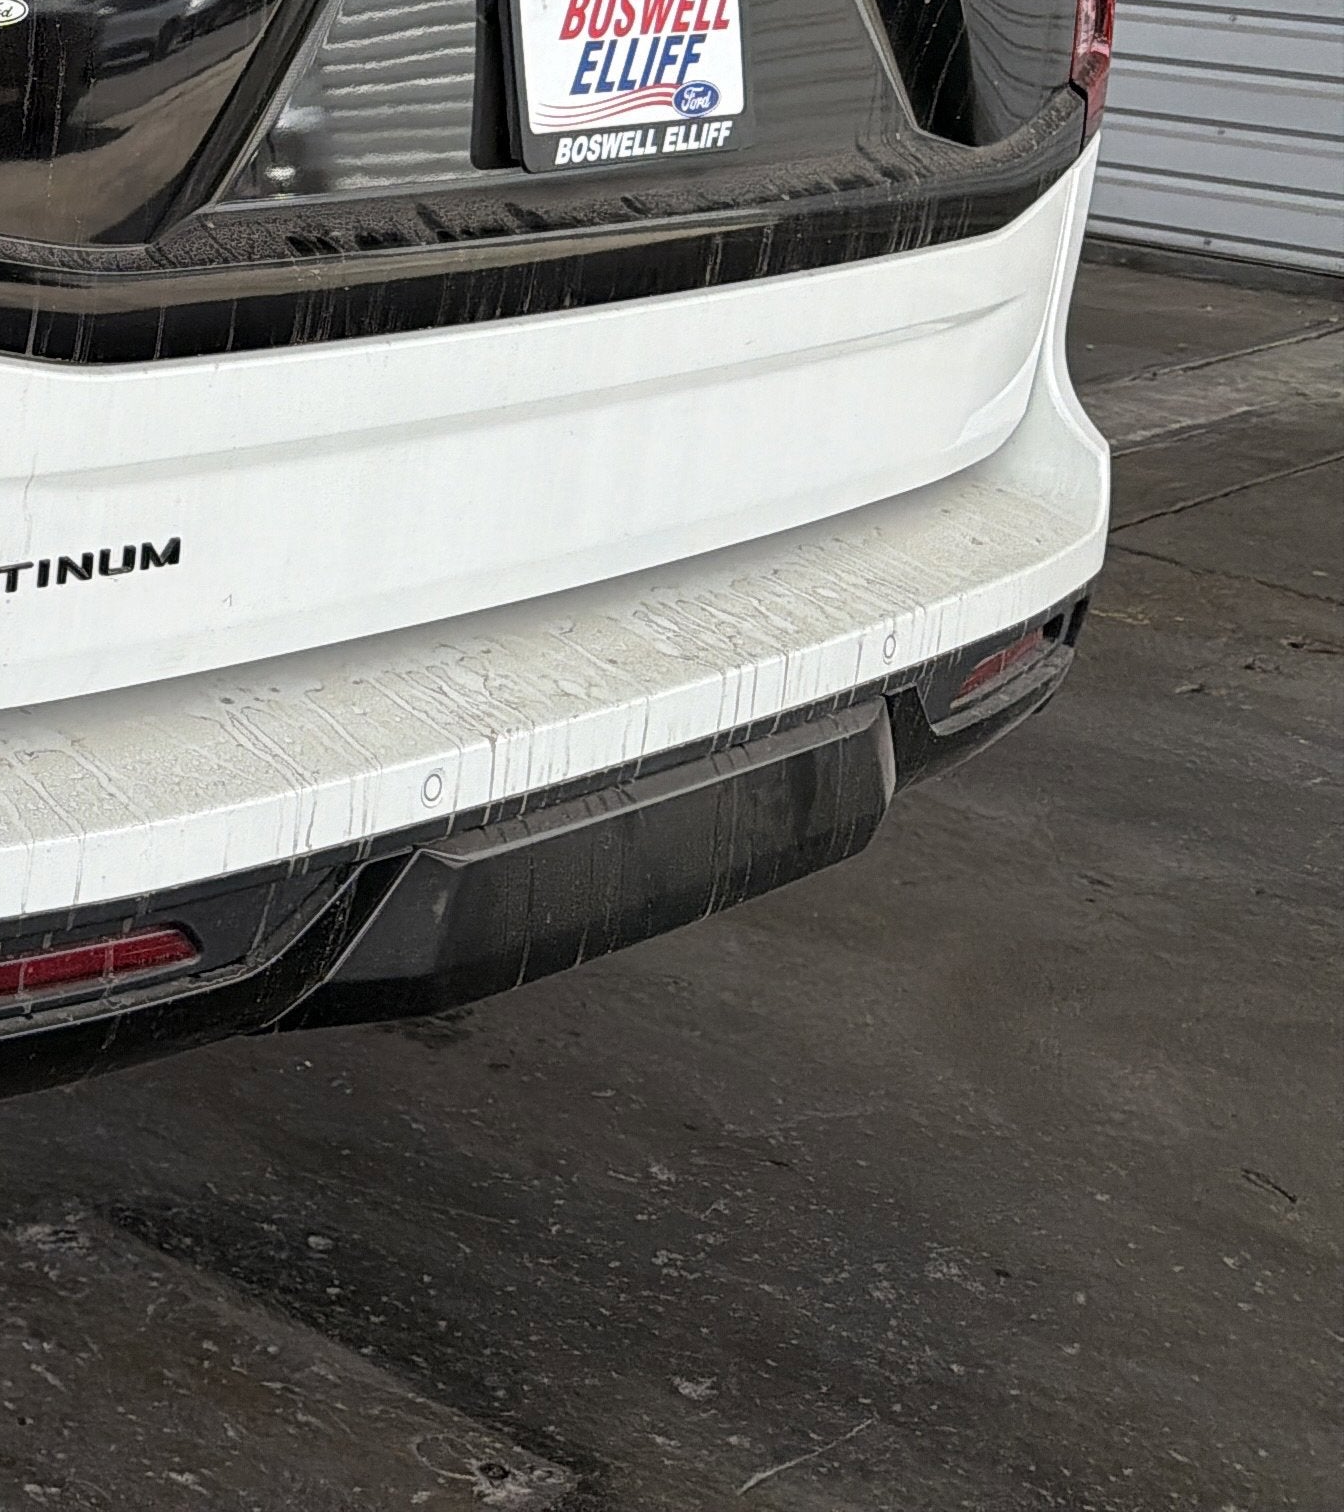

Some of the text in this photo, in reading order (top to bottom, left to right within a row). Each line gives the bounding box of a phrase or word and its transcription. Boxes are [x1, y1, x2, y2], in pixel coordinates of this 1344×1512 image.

[569, 33, 707, 95] ELLIFF
[555, 121, 733, 165] BOSWELL ELLIFF
